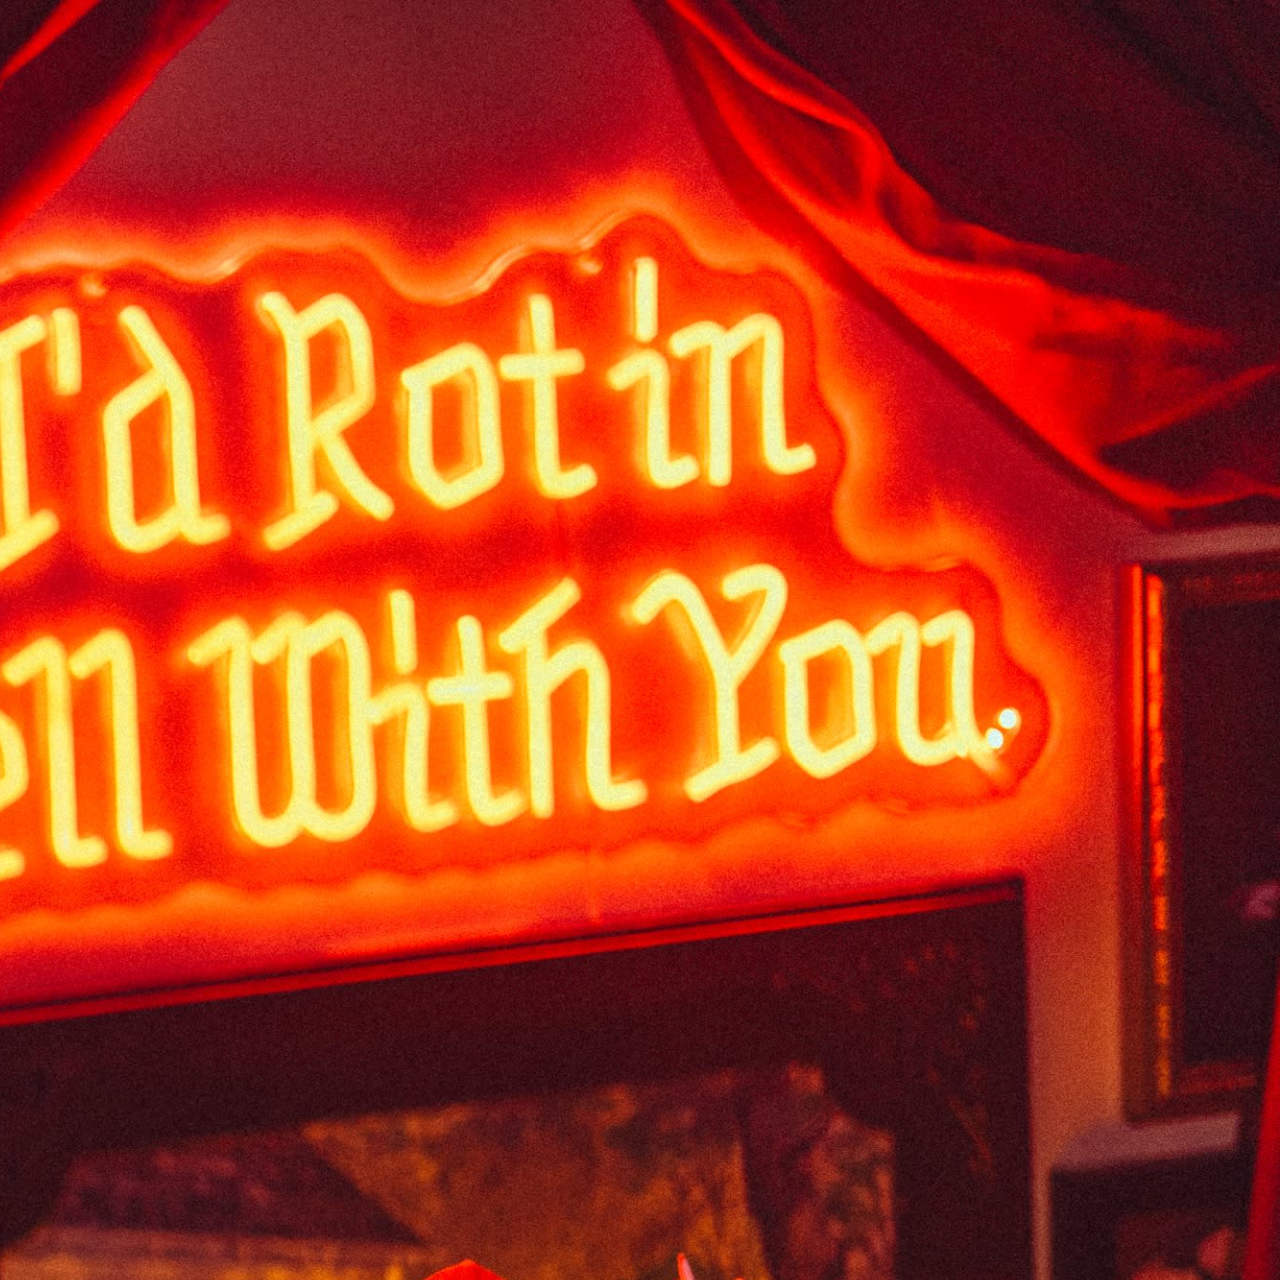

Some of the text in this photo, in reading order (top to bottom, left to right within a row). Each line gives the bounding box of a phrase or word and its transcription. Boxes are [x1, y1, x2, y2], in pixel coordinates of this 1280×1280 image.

[262, 292, 597, 550] Rot
[609, 257, 816, 489] in
[189, 578, 646, 846] With
